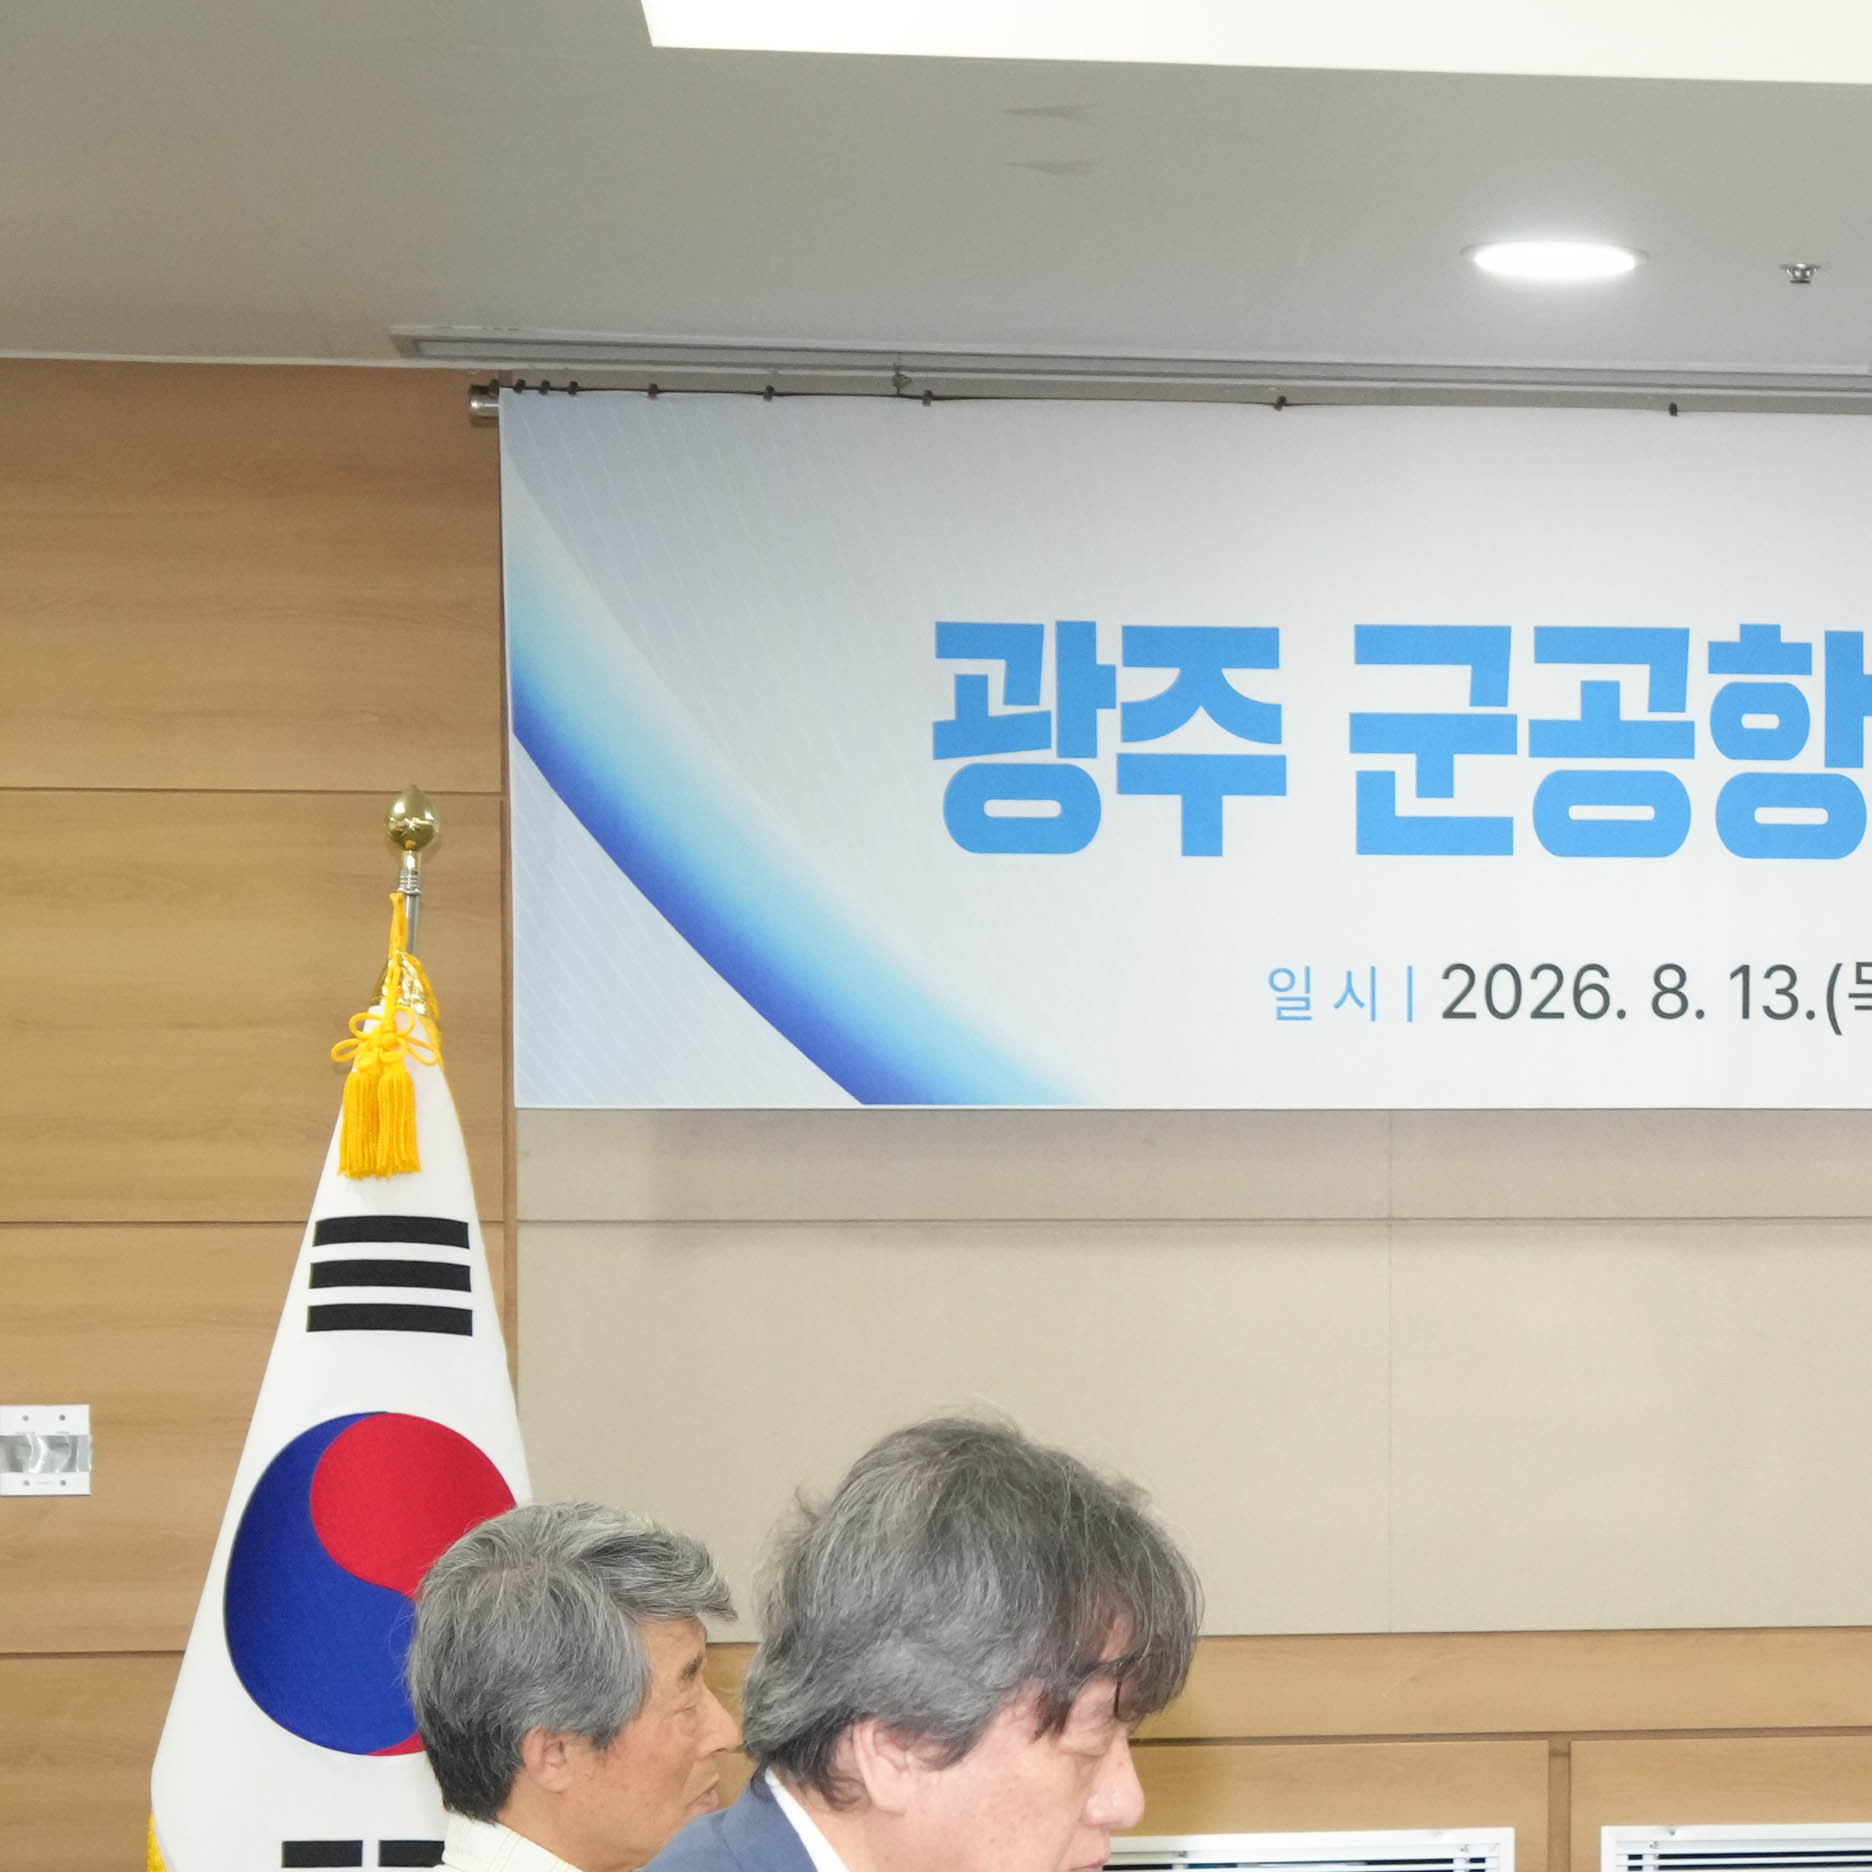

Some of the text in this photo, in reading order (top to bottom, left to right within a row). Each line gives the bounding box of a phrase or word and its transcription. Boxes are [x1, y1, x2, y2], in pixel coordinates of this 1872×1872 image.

[933, 620, 1288, 858] 광주
[1441, 963, 1629, 1022] 2026.
[1651, 963, 1707, 1022] 8.
